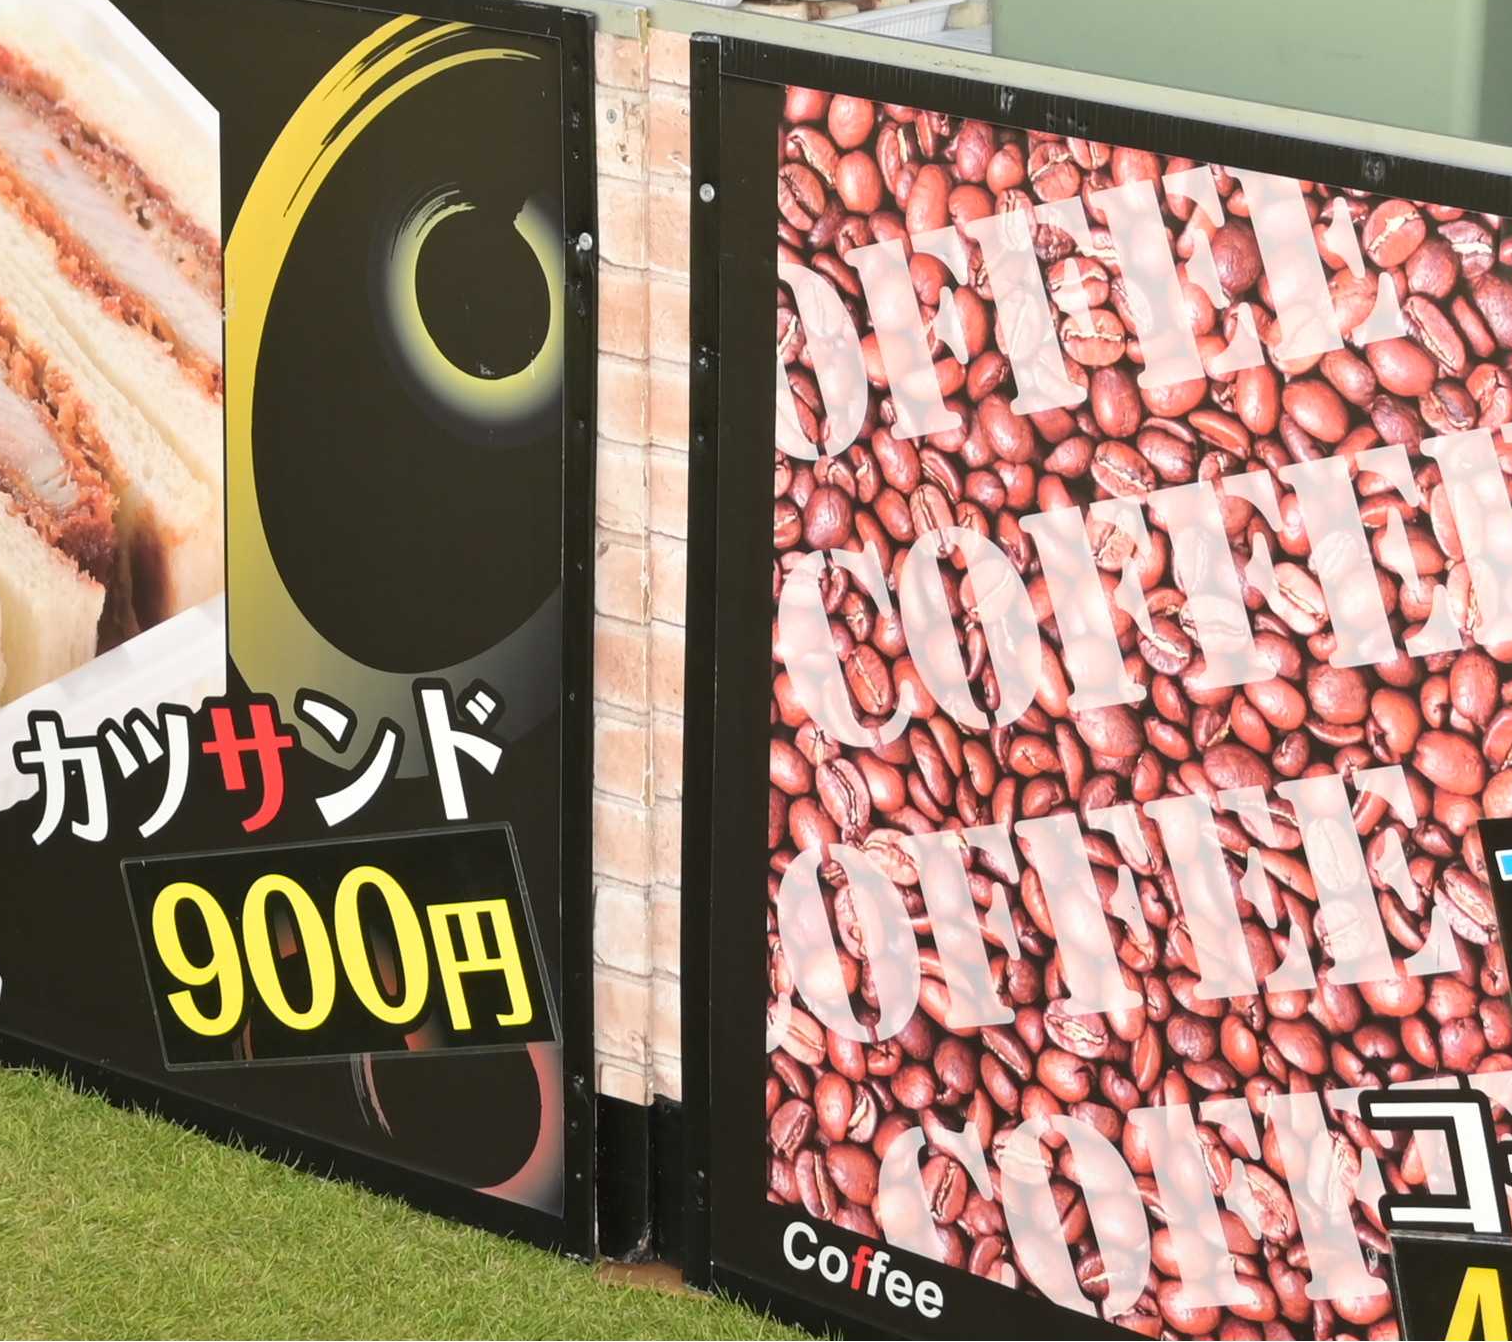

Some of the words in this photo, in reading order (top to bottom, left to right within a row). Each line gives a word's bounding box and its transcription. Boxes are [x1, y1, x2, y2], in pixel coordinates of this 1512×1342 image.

[20, 688, 505, 846] カツサンド
[151, 864, 534, 1038] 900円
[768, 765, 1462, 1049] OFFEE
[782, 1220, 945, 1320] Coffee
